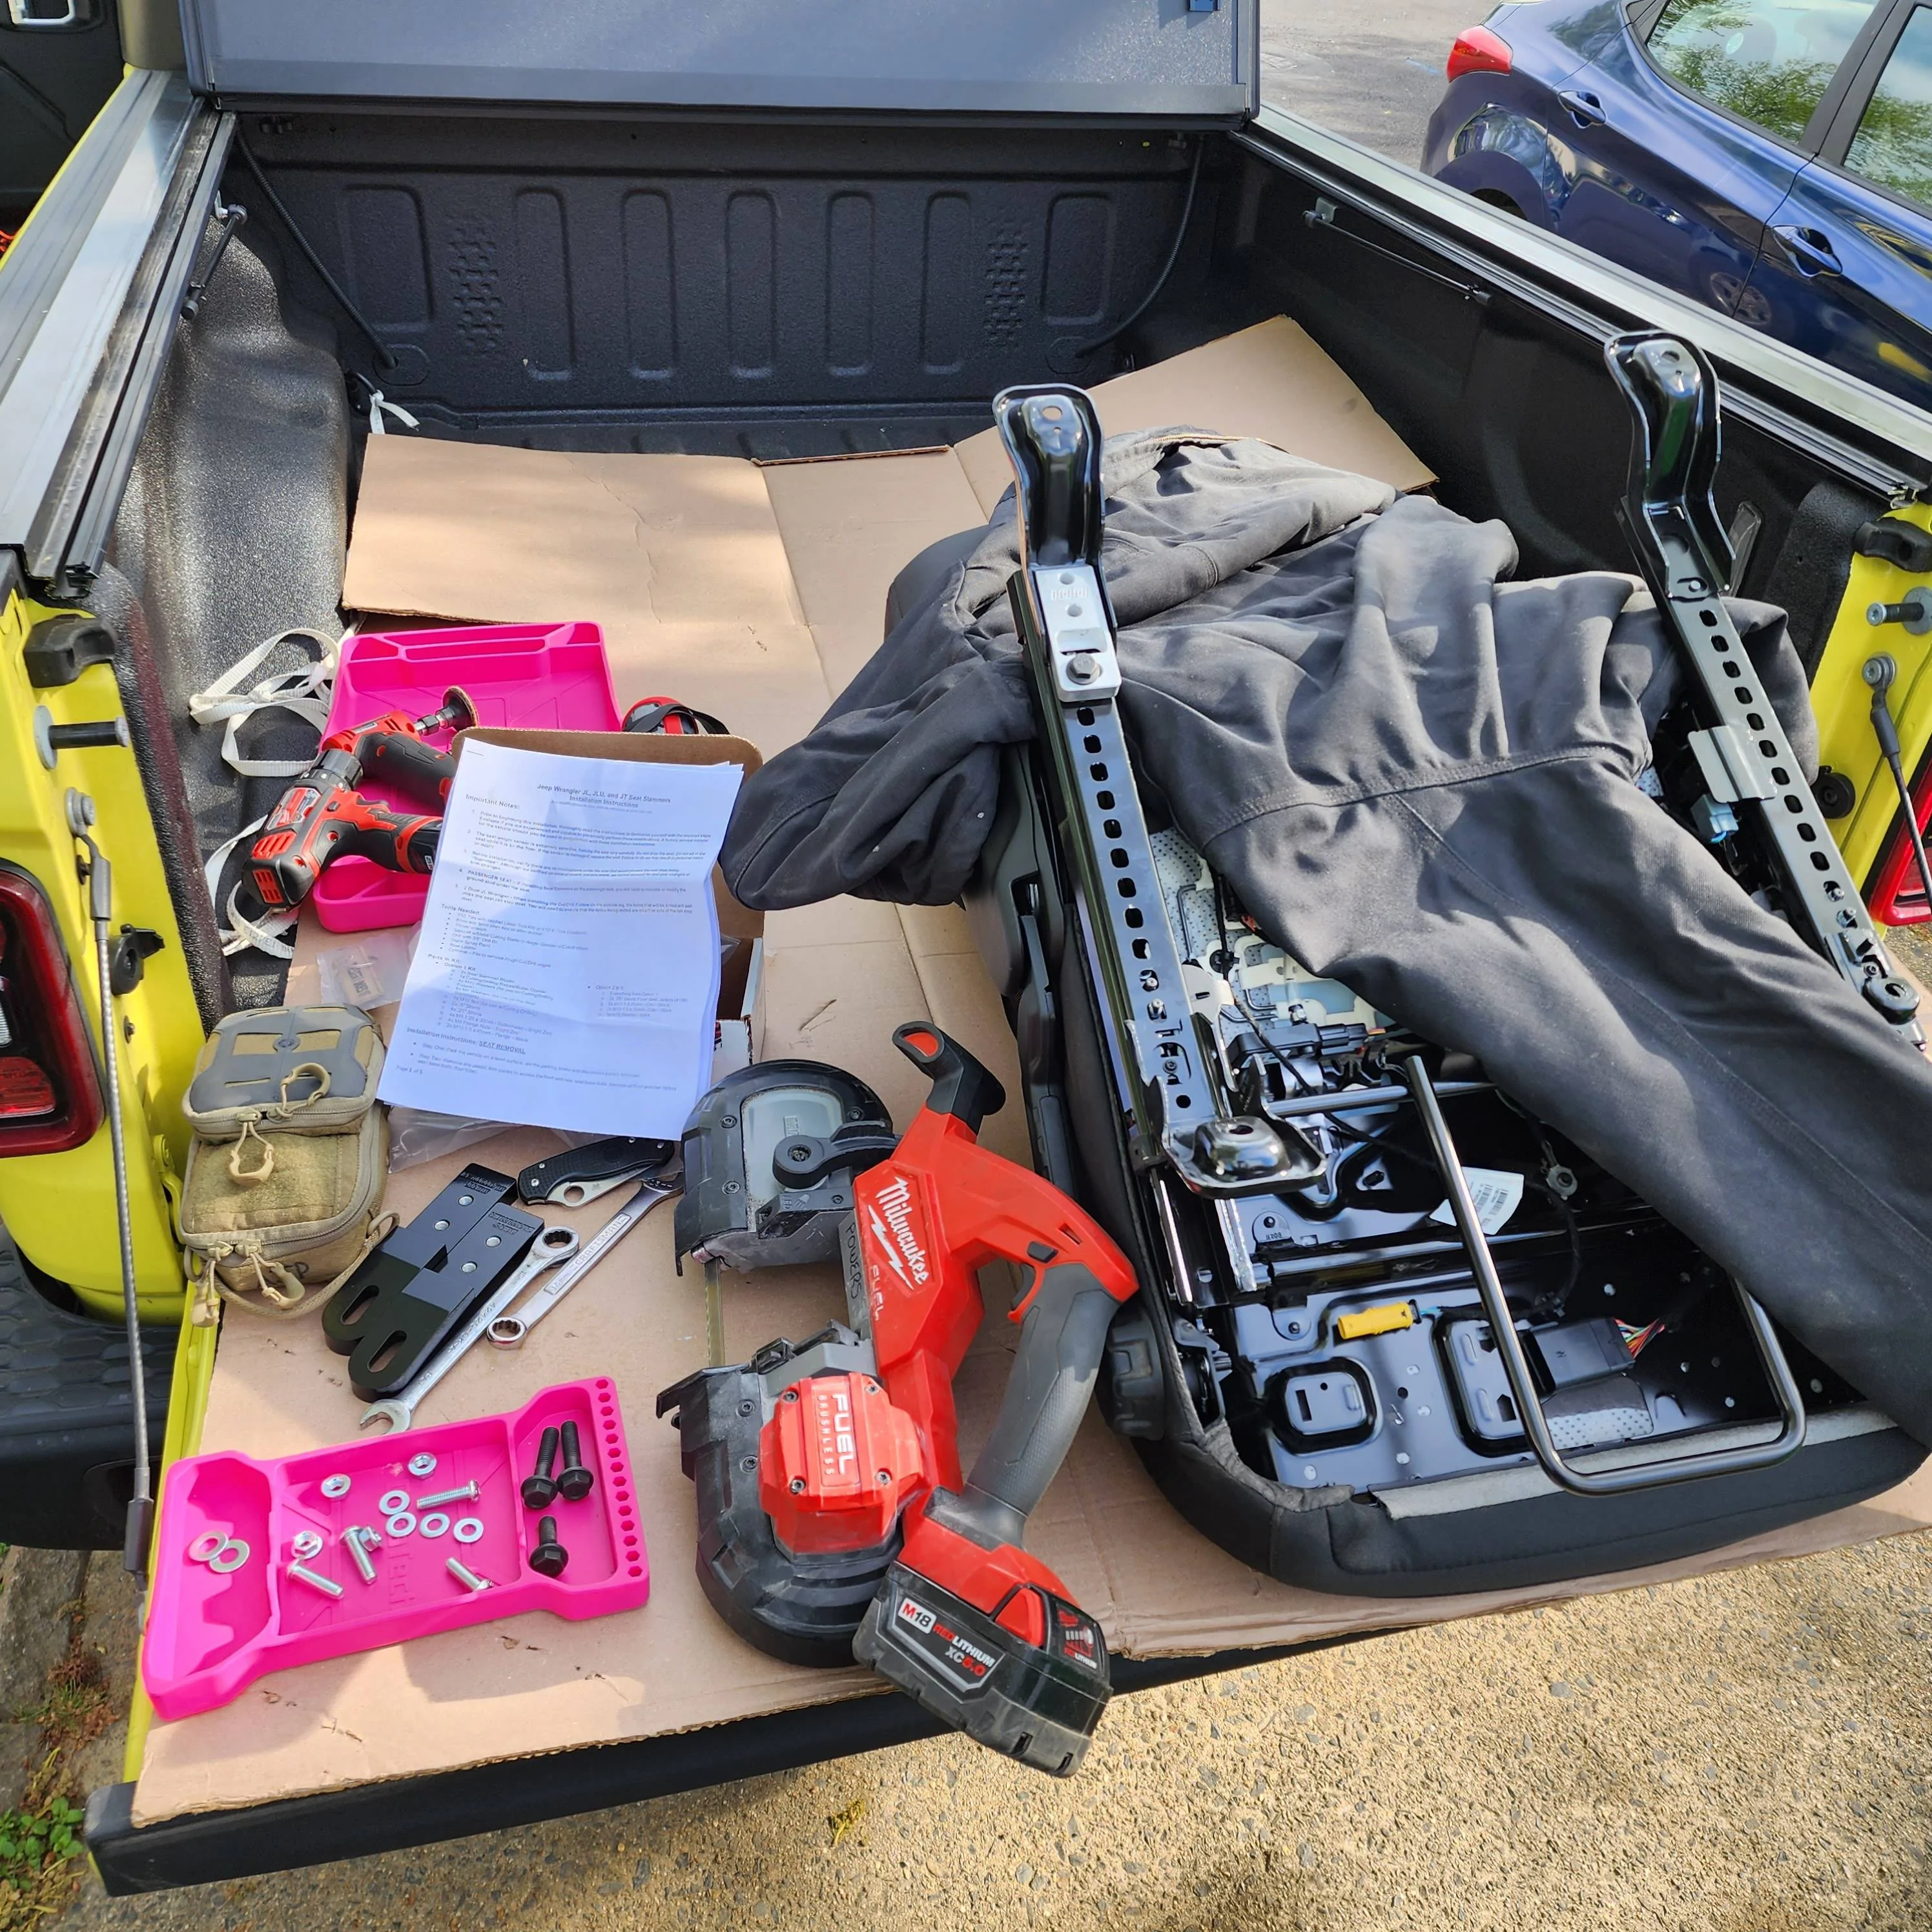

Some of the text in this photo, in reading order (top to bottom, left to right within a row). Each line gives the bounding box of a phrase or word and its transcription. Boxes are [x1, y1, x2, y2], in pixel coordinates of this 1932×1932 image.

[466, 794, 497, 805] Important
[468, 870, 498, 879] PASSENGER
[407, 1028, 440, 1037] Installation
[441, 1034, 477, 1044] Instructions:
[496, 1044, 525, 1054] REMOVAL
[575, 1220, 621, 1267] CRAFTSMAN
[874, 1176, 929, 1285] Milwaukee
[845, 1222, 862, 1299] POWERS
[870, 1265, 883, 1321] FUEL
[818, 1395, 835, 1475] BRUSHLESS
[831, 1393, 854, 1475] FUEL
[903, 1603, 932, 1628] M18
[945, 1646, 985, 1676] XC5.0
